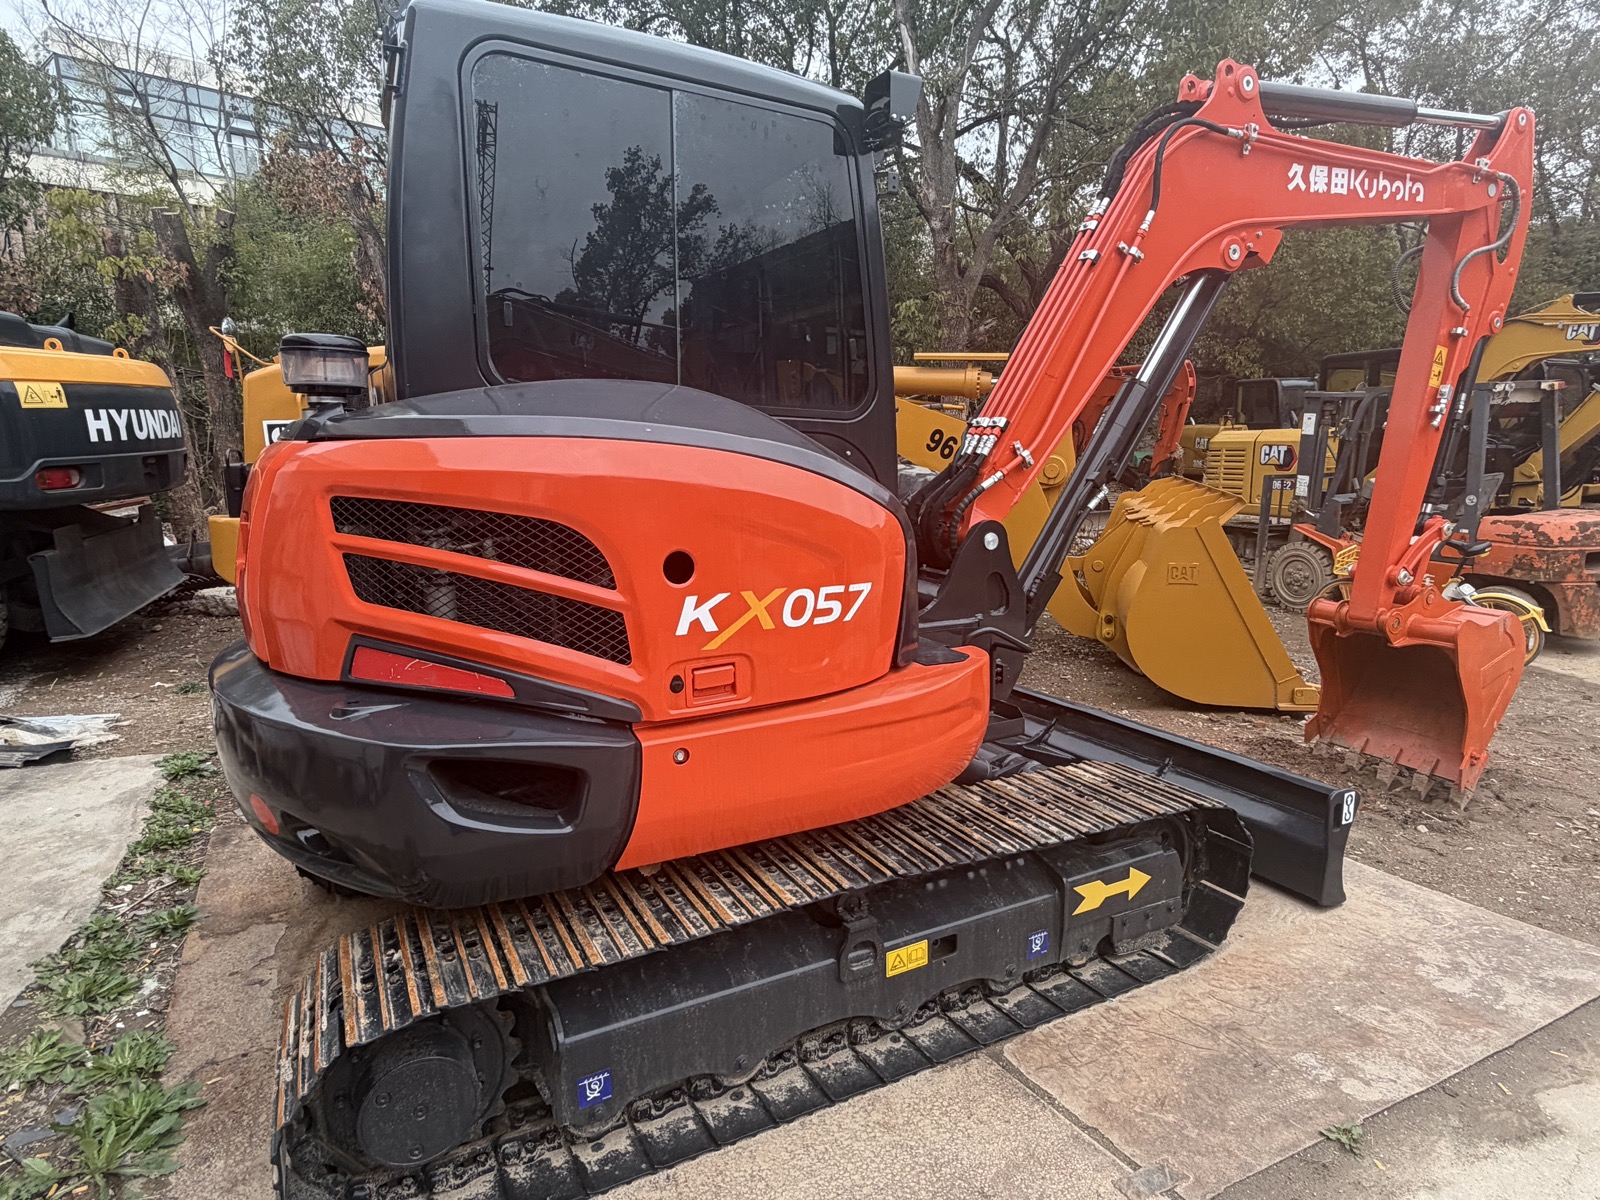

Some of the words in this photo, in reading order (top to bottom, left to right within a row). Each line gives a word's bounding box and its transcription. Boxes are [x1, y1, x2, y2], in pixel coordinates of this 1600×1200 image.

[1566, 323, 1600, 341] CAT
[84, 408, 182, 443] HYUNDAI
[1195, 437, 1209, 450] CAT
[1260, 445, 1288, 465] CAT
[1170, 566, 1198, 581] CAT
[675, 582, 873, 651] KX057
